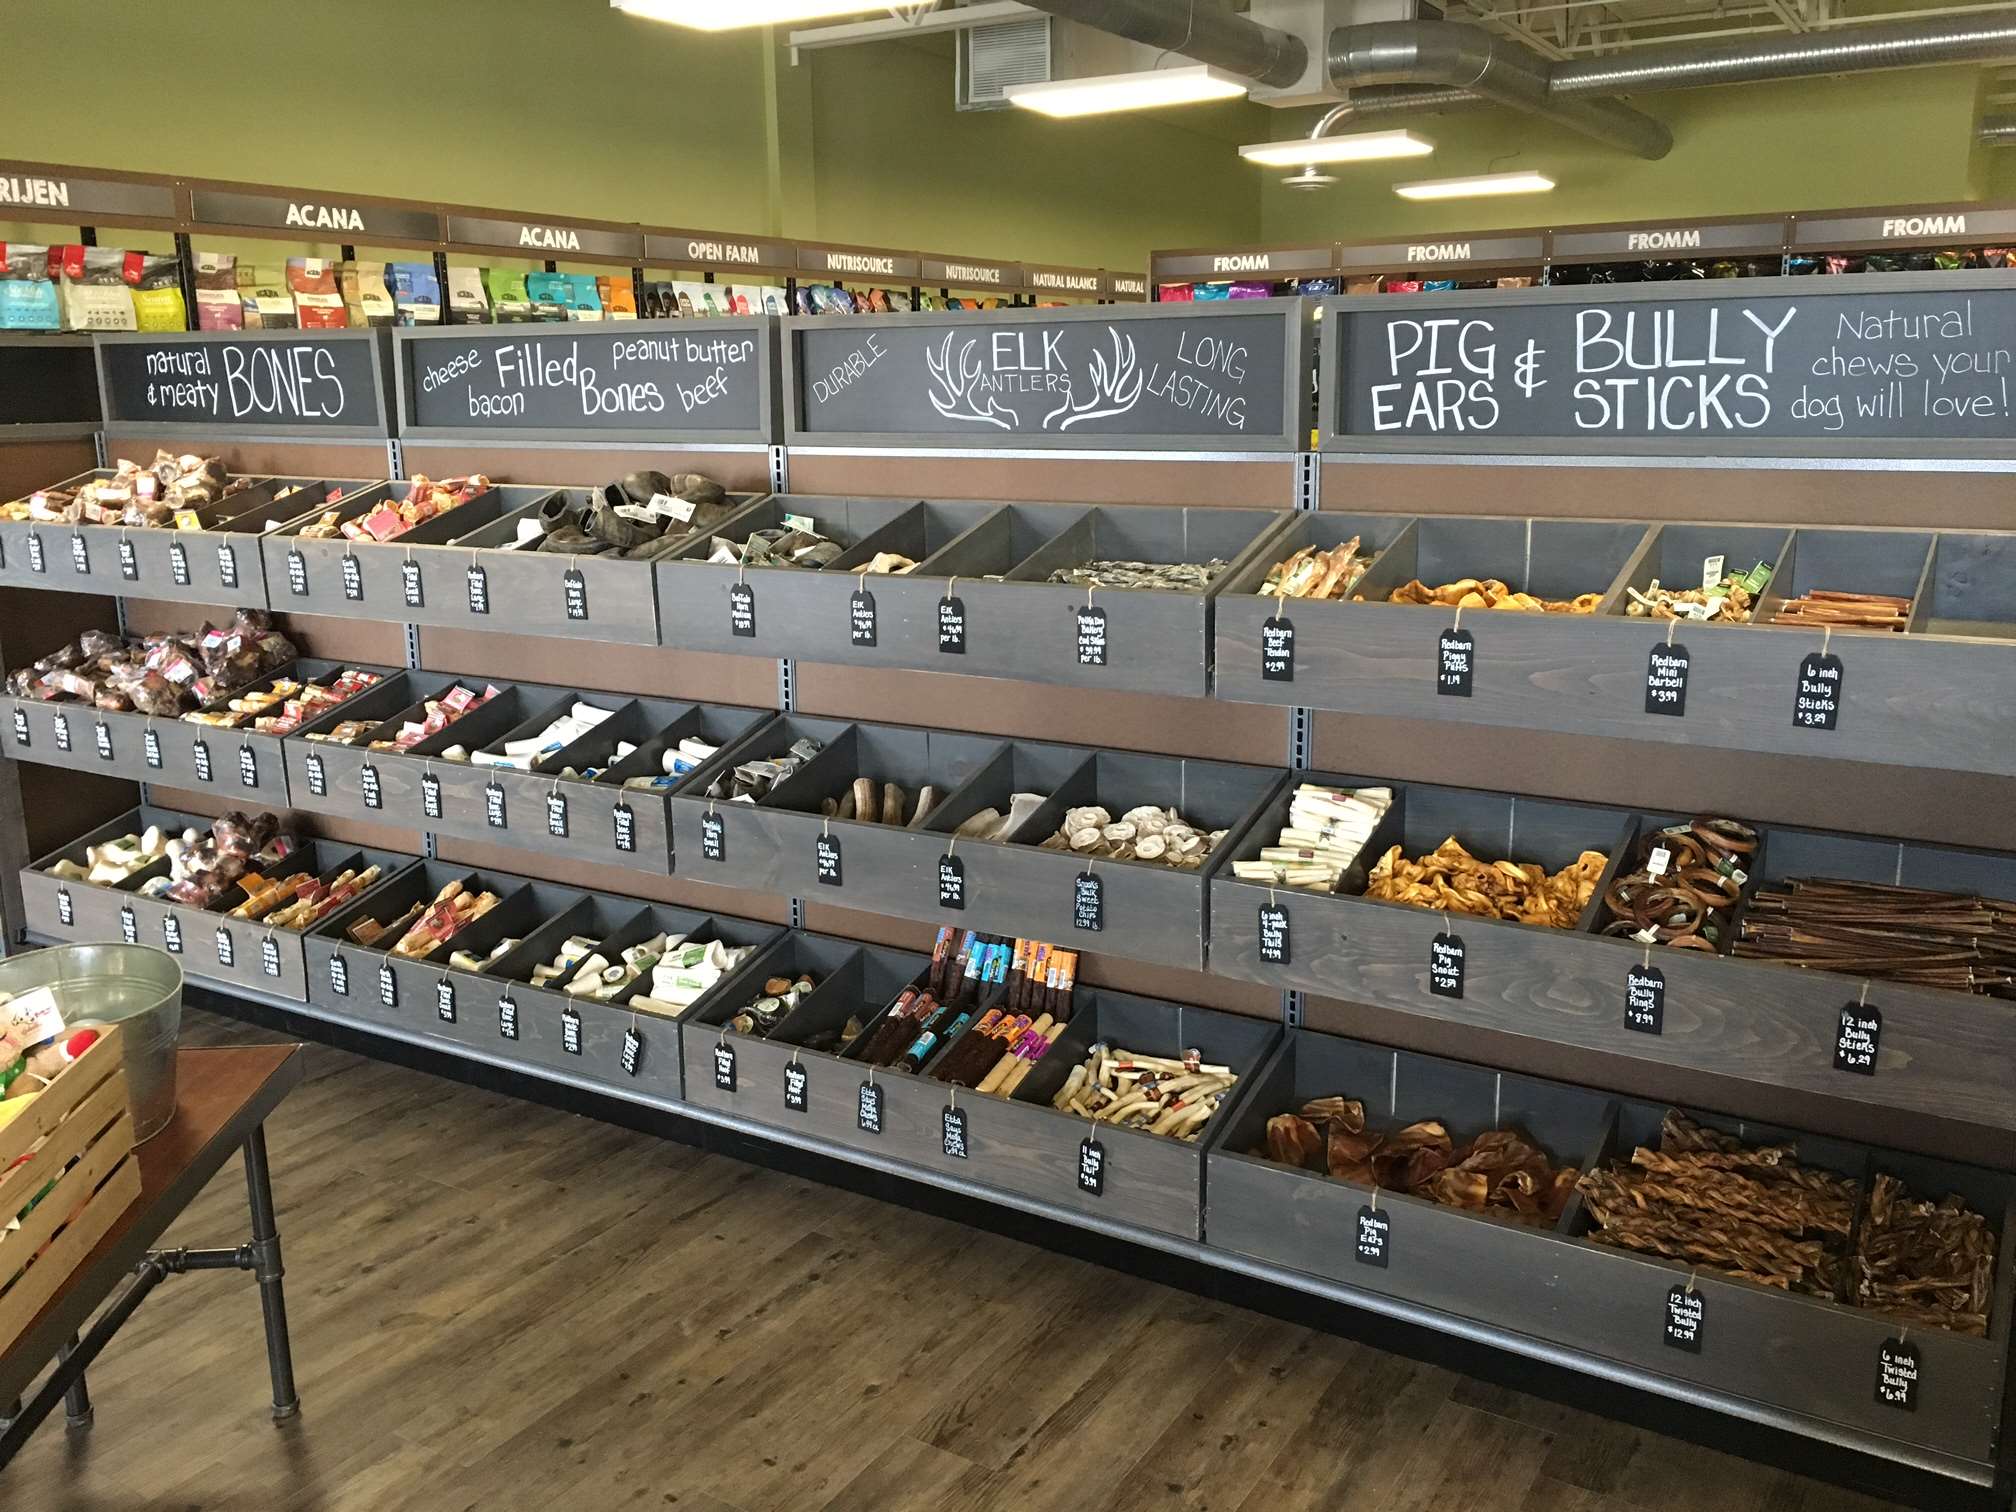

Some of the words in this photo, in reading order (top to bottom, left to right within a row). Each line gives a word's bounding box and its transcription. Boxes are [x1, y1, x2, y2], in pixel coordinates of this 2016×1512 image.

[286, 203, 364, 231] ACANA
[1883, 216, 1965, 237] FROMM
[520, 227, 580, 250] ACANA
[1628, 231, 1700, 250] FROMM
[688, 242, 722, 261] OPEN
[726, 245, 758, 263] FARM
[1408, 244, 1470, 262] FROMM
[828, 254, 893, 274] NUTRISOURCE
[1214, 255, 1269, 272] FROMM
[946, 265, 1000, 283] NUTRISOURCE
[1033, 273, 1065, 288] NATURAL
[1066, 275, 1097, 290] BALANCE
[1115, 280, 1144, 293] NATURAL
[1836, 299, 1972, 340] Natural
[1576, 306, 1797, 375] BULLY
[611, 337, 680, 370] peanut
[685, 337, 754, 364] butter
[992, 330, 1066, 372] ELK
[1176, 330, 1248, 384] LONG
[1386, 319, 1496, 379] PIG
[1513, 338, 1546, 398] &
[146, 346, 212, 377] natural
[422, 347, 483, 392] cheese
[494, 340, 579, 389] Filled
[813, 333, 888, 404] DURABLE
[1811, 348, 1919, 379] chews
[1932, 349, 2012, 381] your
[222, 345, 345, 418] BONES
[980, 372, 1072, 393] ANTLERS
[160, 378, 218, 416] meaty
[578, 367, 665, 416] Bones
[676, 366, 728, 413] beef
[1146, 363, 1247, 430] LASTING
[468, 385, 525, 418] bacon
[1371, 379, 1499, 432] EARS
[1573, 374, 1770, 431] STICKS
[1790, 379, 1843, 431] dog
[1855, 379, 1904, 419] will
[1923, 377, 2010, 419] love!
[852, 631, 863, 640] per
[940, 634, 950, 644] per
[1264, 626, 1292, 638] Redbarn
[1268, 637, 1284, 647] Beef
[1441, 639, 1471, 650] Redbarn
[1264, 647, 1290, 657] Tendon
[1443, 650, 1466, 664] Piggy
[1444, 661, 1469, 672] Puffs
[1651, 654, 1688, 668] Redbarn
[1658, 667, 1677, 677] Mini
[1807, 664, 1816, 676] 6
[1819, 667, 1838, 680] inch
[1648, 675, 1682, 688] Barbell
[1801, 680, 1831, 697] Bully
[1651, 689, 1677, 702] $3.99
[1798, 697, 1834, 710] Sticks
[819, 868, 829, 876] per
[941, 892, 951, 900] per
[1076, 894, 1100, 904] Sweet
[1268, 911, 1283, 920] inch
[1262, 938, 1282, 948] Tails
[1263, 929, 1282, 940] Bully
[1262, 948, 1281, 959] $4.99
[1433, 942, 1462, 957] Redbarn
[1432, 963, 1460, 976] Snout
[1438, 954, 1452, 968] Pig
[1628, 974, 1663, 990] Redbarn
[1630, 987, 1654, 1001] Bully
[1629, 996, 1654, 1012] Rings
[1842, 1016, 1854, 1026] 12
[1858, 1018, 1878, 1031] inch
[1845, 1027, 1870, 1044] Bully
[1839, 1037, 1875, 1053] Sticks
[1083, 1154, 1099, 1171] Bully
[1360, 1216, 1388, 1231] Redbarn
[1360, 1234, 1383, 1245] Ears
[1364, 1227, 1377, 1239] Pig
[1670, 1293, 1683, 1304] 12
[1684, 1296, 1701, 1309] inch
[1668, 1302, 1701, 1320] Twisted
[1672, 1314, 1697, 1332] Bully
[1882, 1350, 1890, 1361] 6
[1894, 1355, 1914, 1369] inch
[1880, 1361, 1917, 1380] Twisted
[1882, 1374, 1908, 1393] Bully
